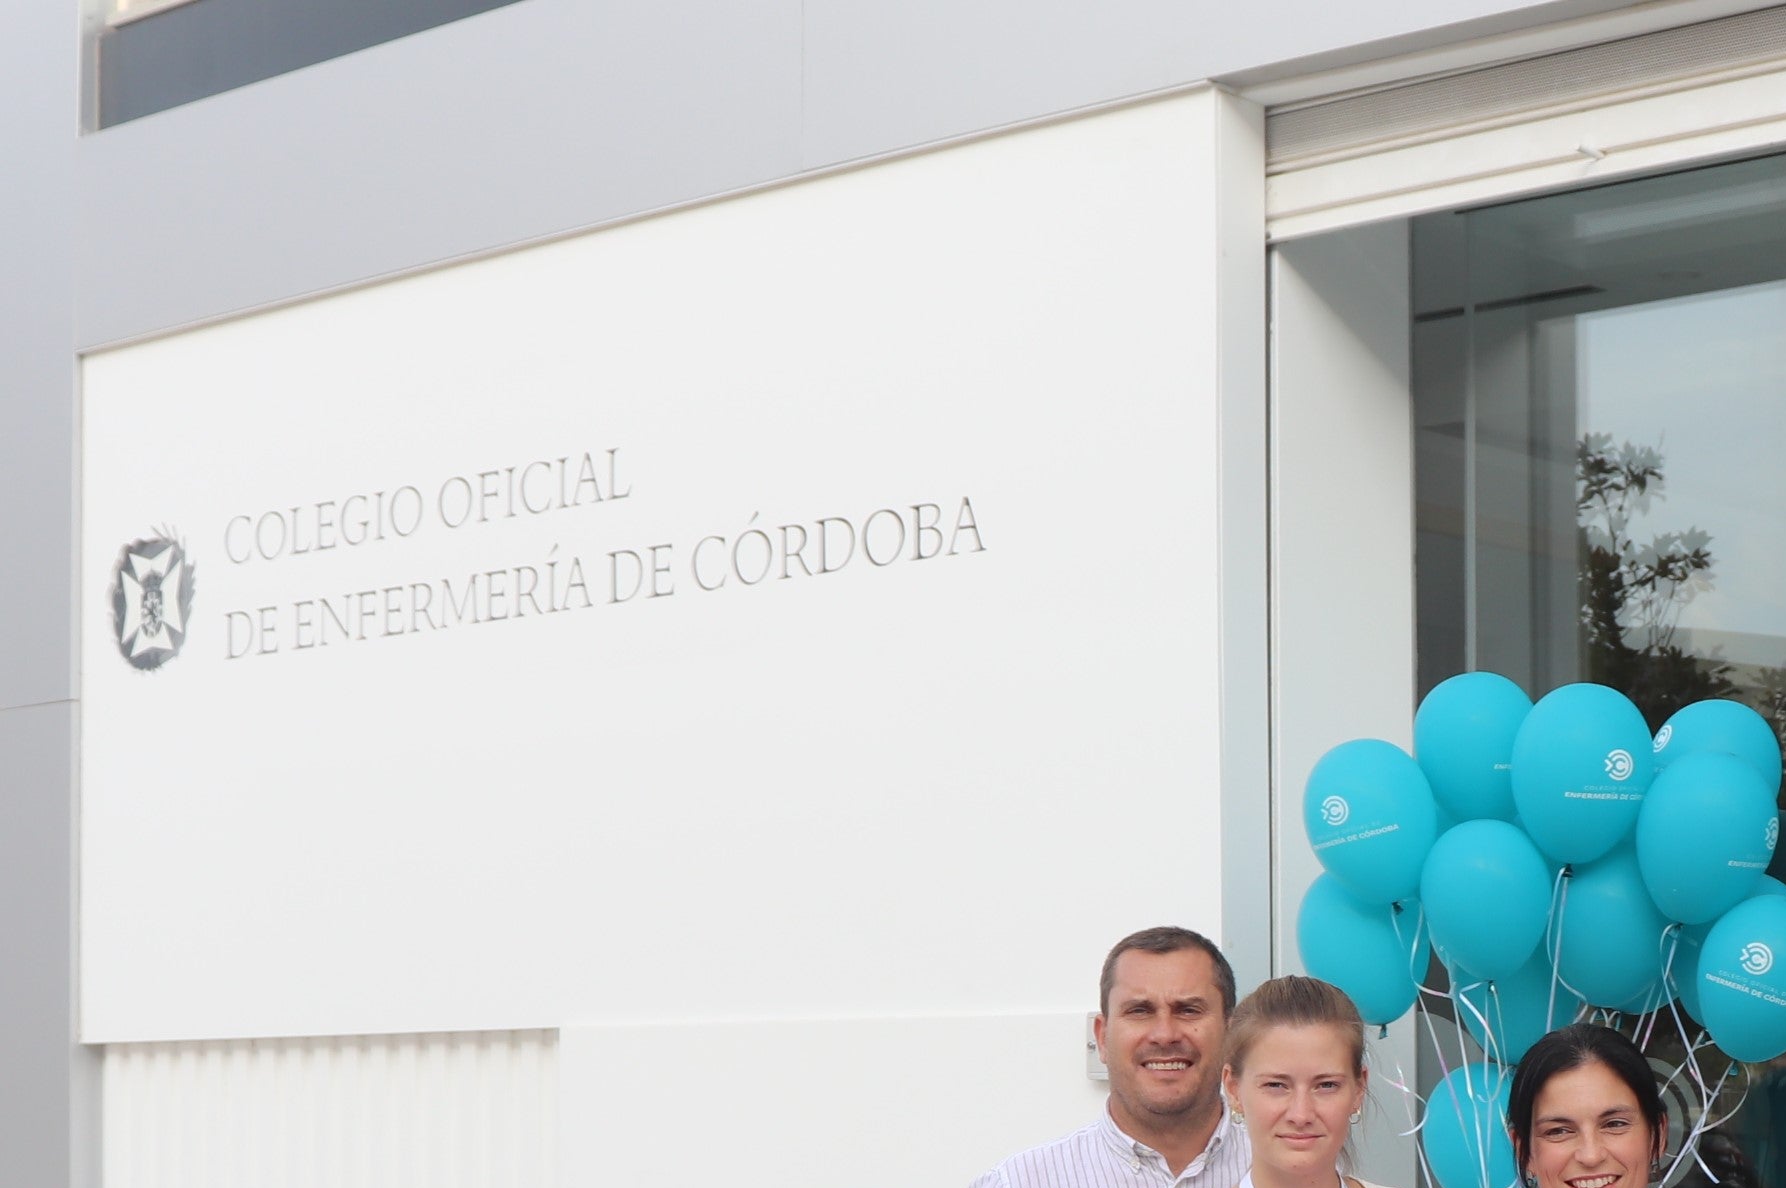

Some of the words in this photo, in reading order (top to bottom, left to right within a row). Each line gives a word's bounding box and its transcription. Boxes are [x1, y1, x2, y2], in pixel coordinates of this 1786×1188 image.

[223, 484, 423, 564] COLEGIO
[438, 448, 632, 529] OFICIAL
[225, 607, 279, 660] DE
[293, 543, 593, 652] ENFERMERÍA
[607, 543, 675, 605] DE
[691, 495, 987, 592] CÓRDOBA
[1358, 823, 1399, 839] CÓRDOBA
[1751, 989, 1763, 998] DE
